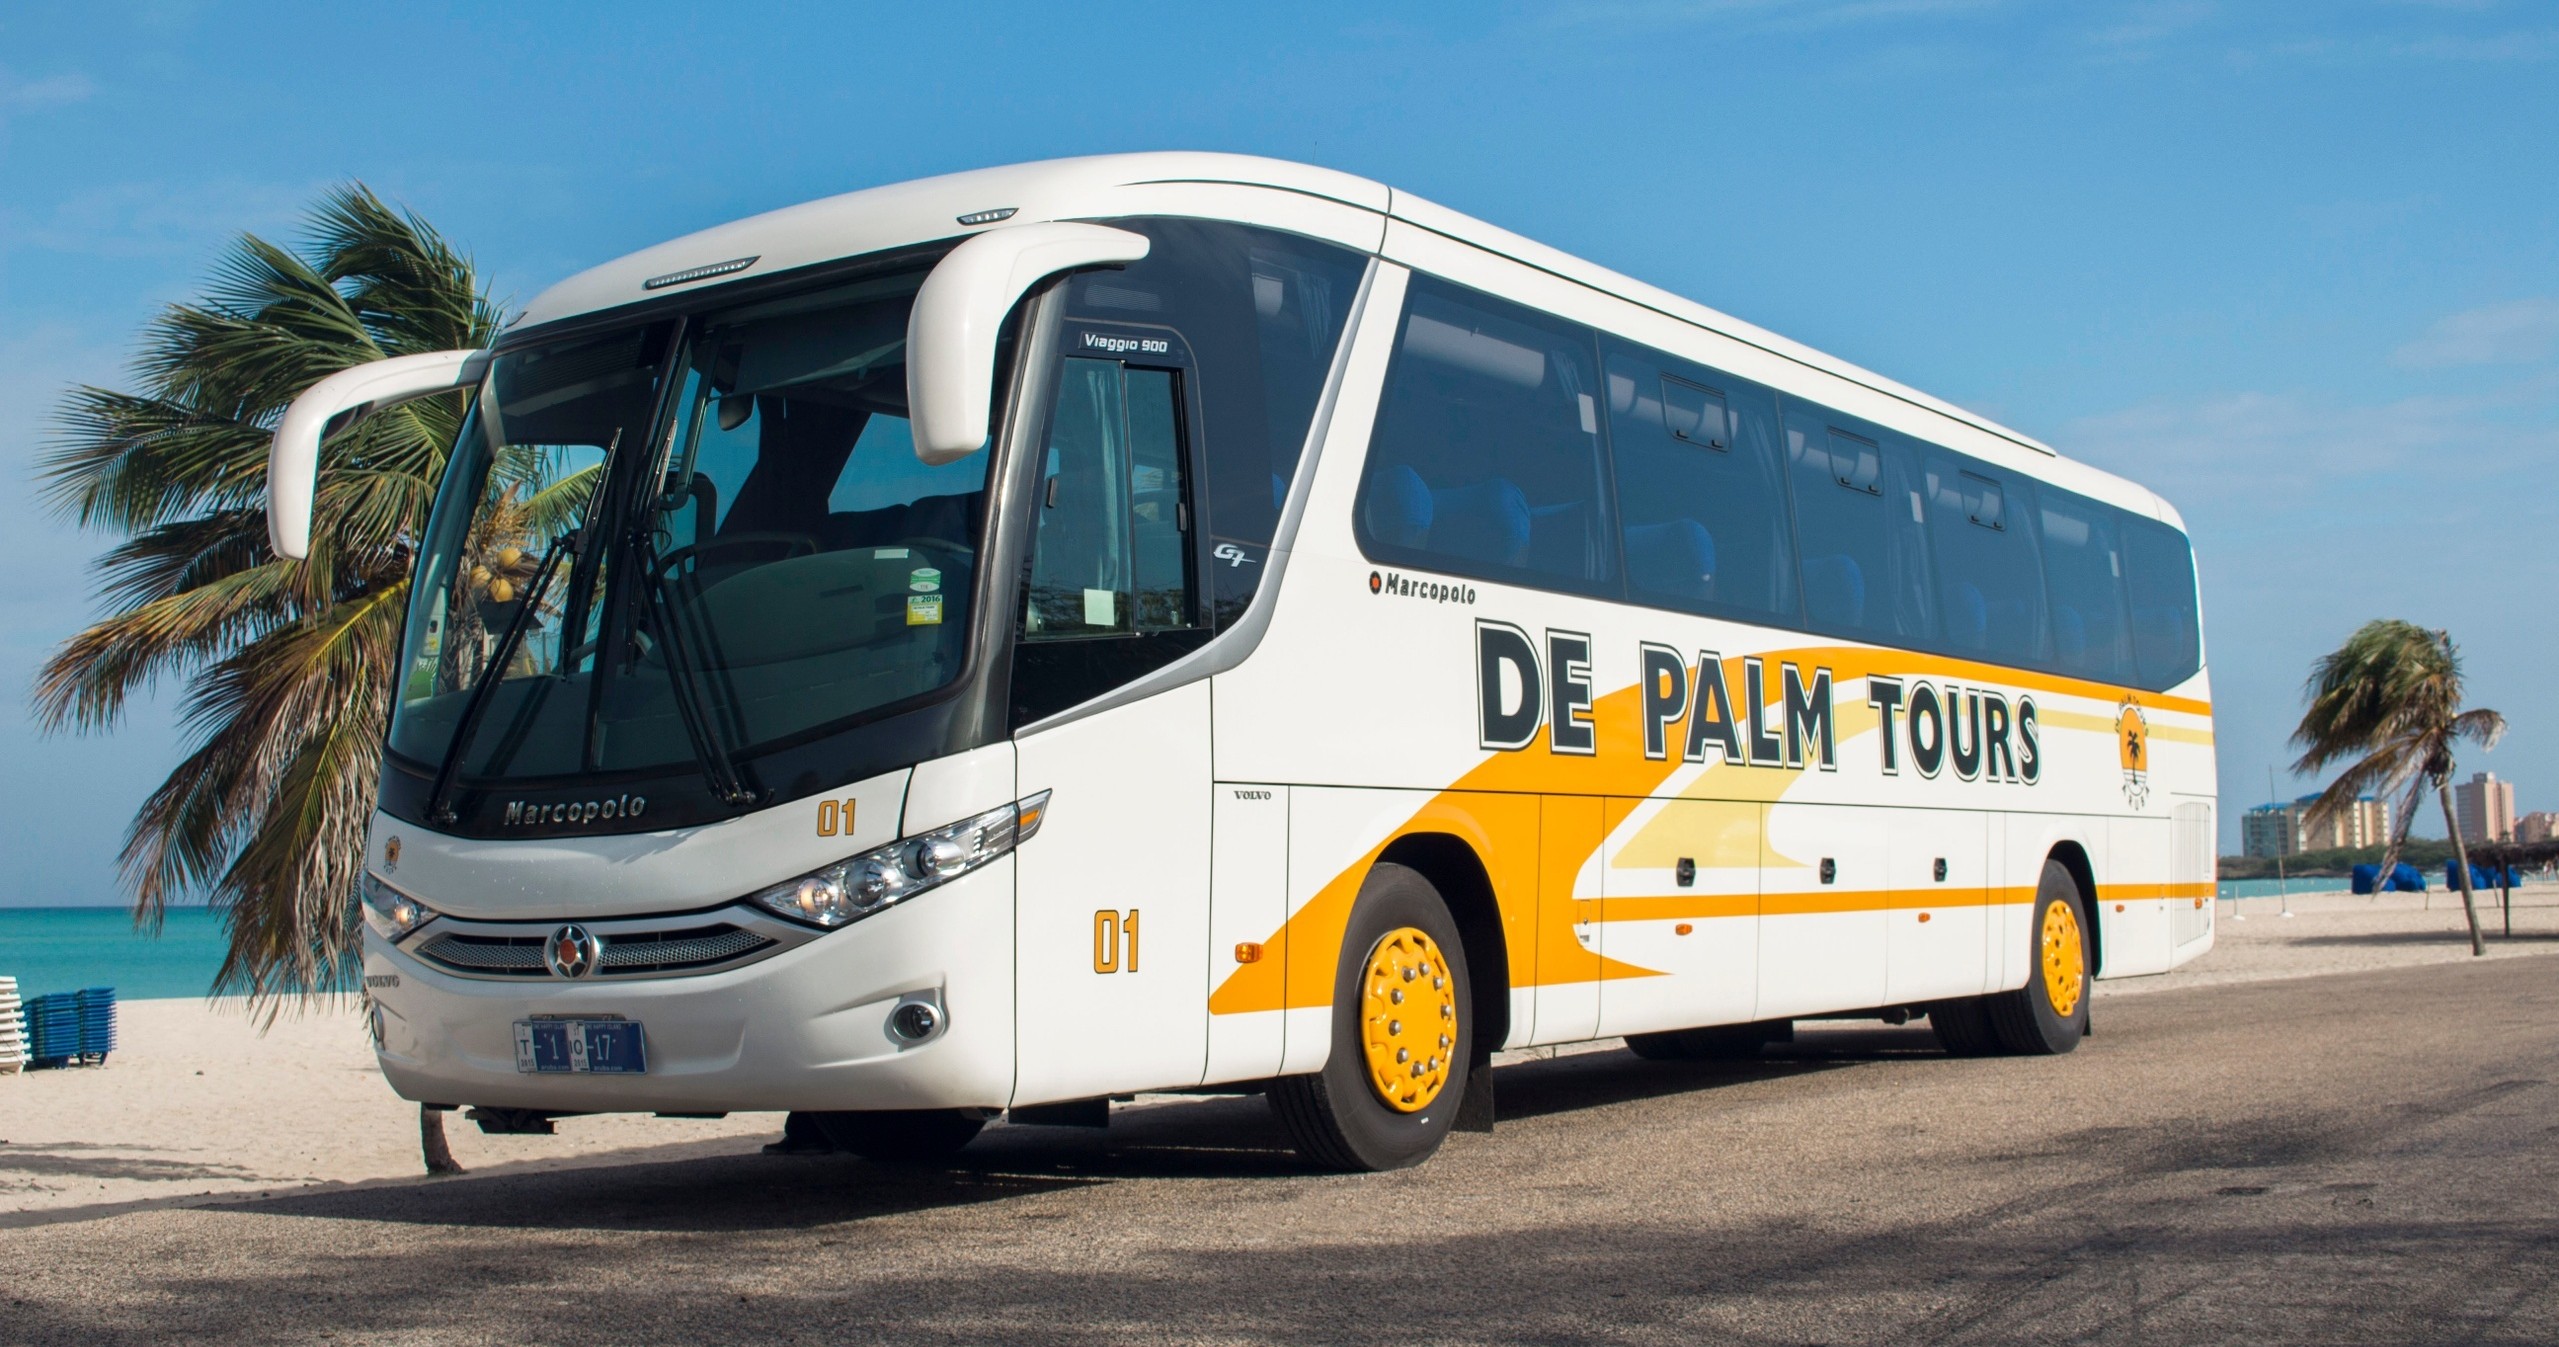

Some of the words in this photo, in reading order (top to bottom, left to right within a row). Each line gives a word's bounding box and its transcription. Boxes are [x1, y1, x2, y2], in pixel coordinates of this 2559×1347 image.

[1084, 333, 1139, 352] Viaggio
[1141, 340, 1168, 352] 900
[1385, 572, 1476, 606] Marcopolo
[1475, 617, 1597, 757] DE
[1639, 640, 1838, 773] PALM
[1867, 673, 2042, 786] TOURS
[504, 794, 645, 825] Marcopolo
[1233, 790, 1272, 800] VOLVO
[817, 798, 856, 837] 01
[1094, 909, 1139, 974] 01
